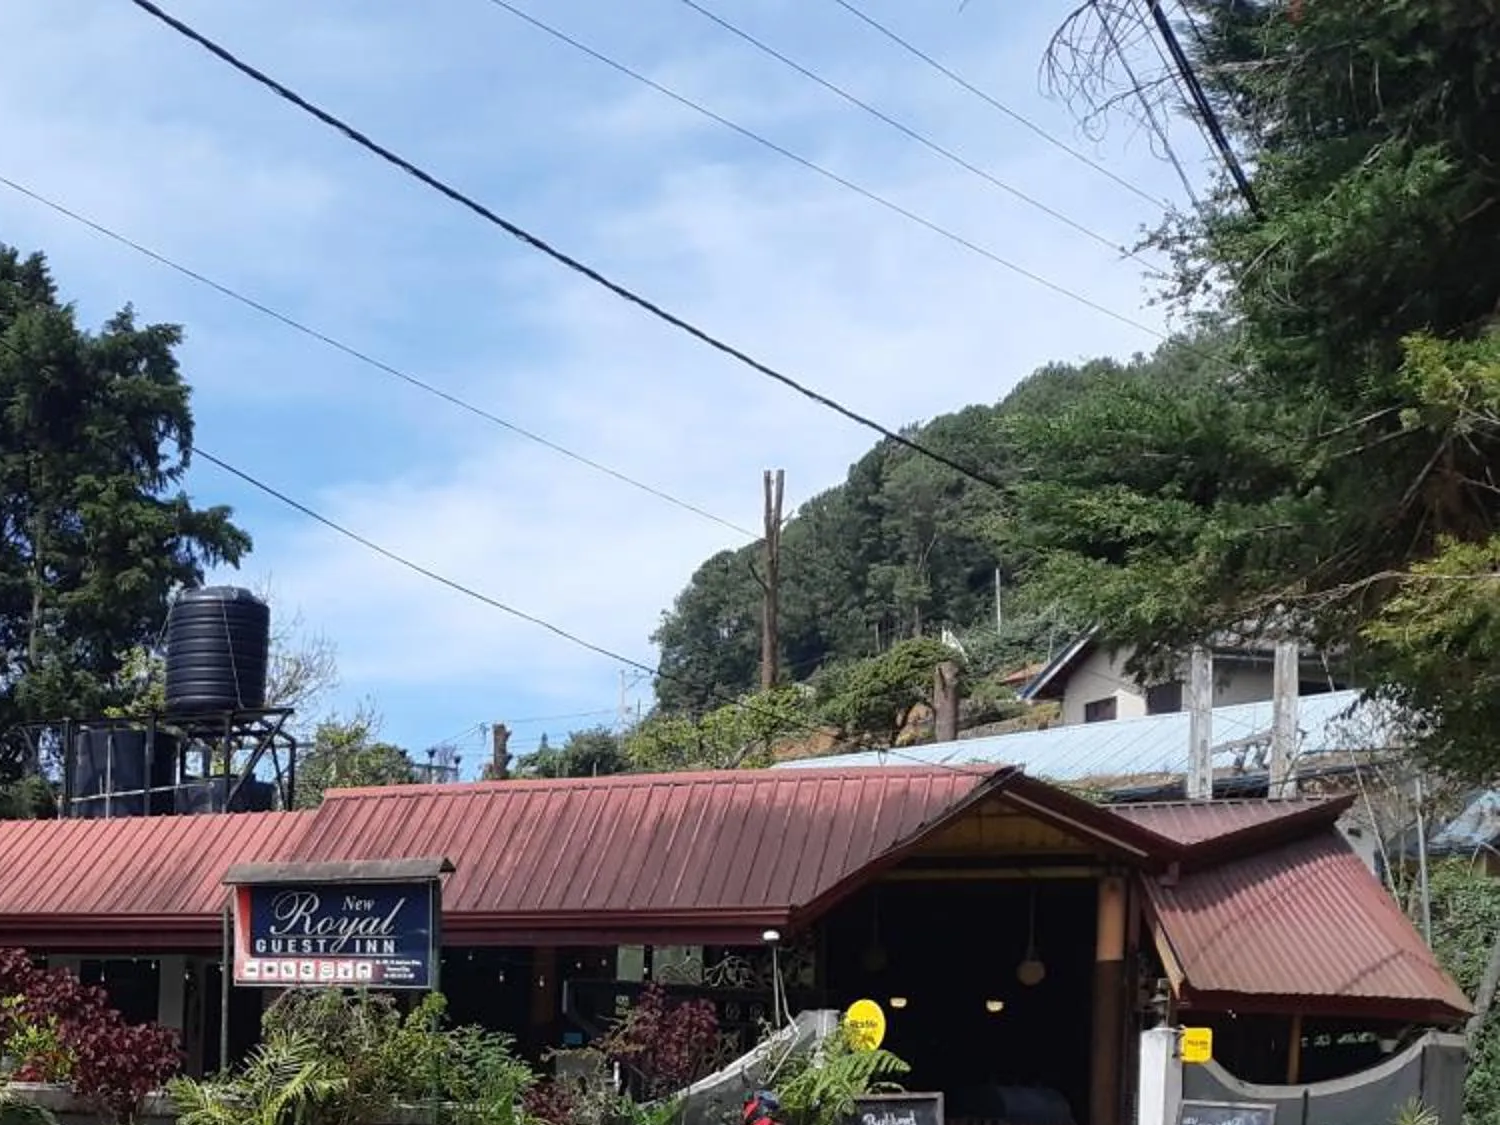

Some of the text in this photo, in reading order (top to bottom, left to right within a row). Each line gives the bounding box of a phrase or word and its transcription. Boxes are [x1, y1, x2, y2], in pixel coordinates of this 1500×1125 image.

[341, 895, 375, 911] New
[269, 891, 406, 953] Royal
[255, 938, 396, 953] GUEST INN
